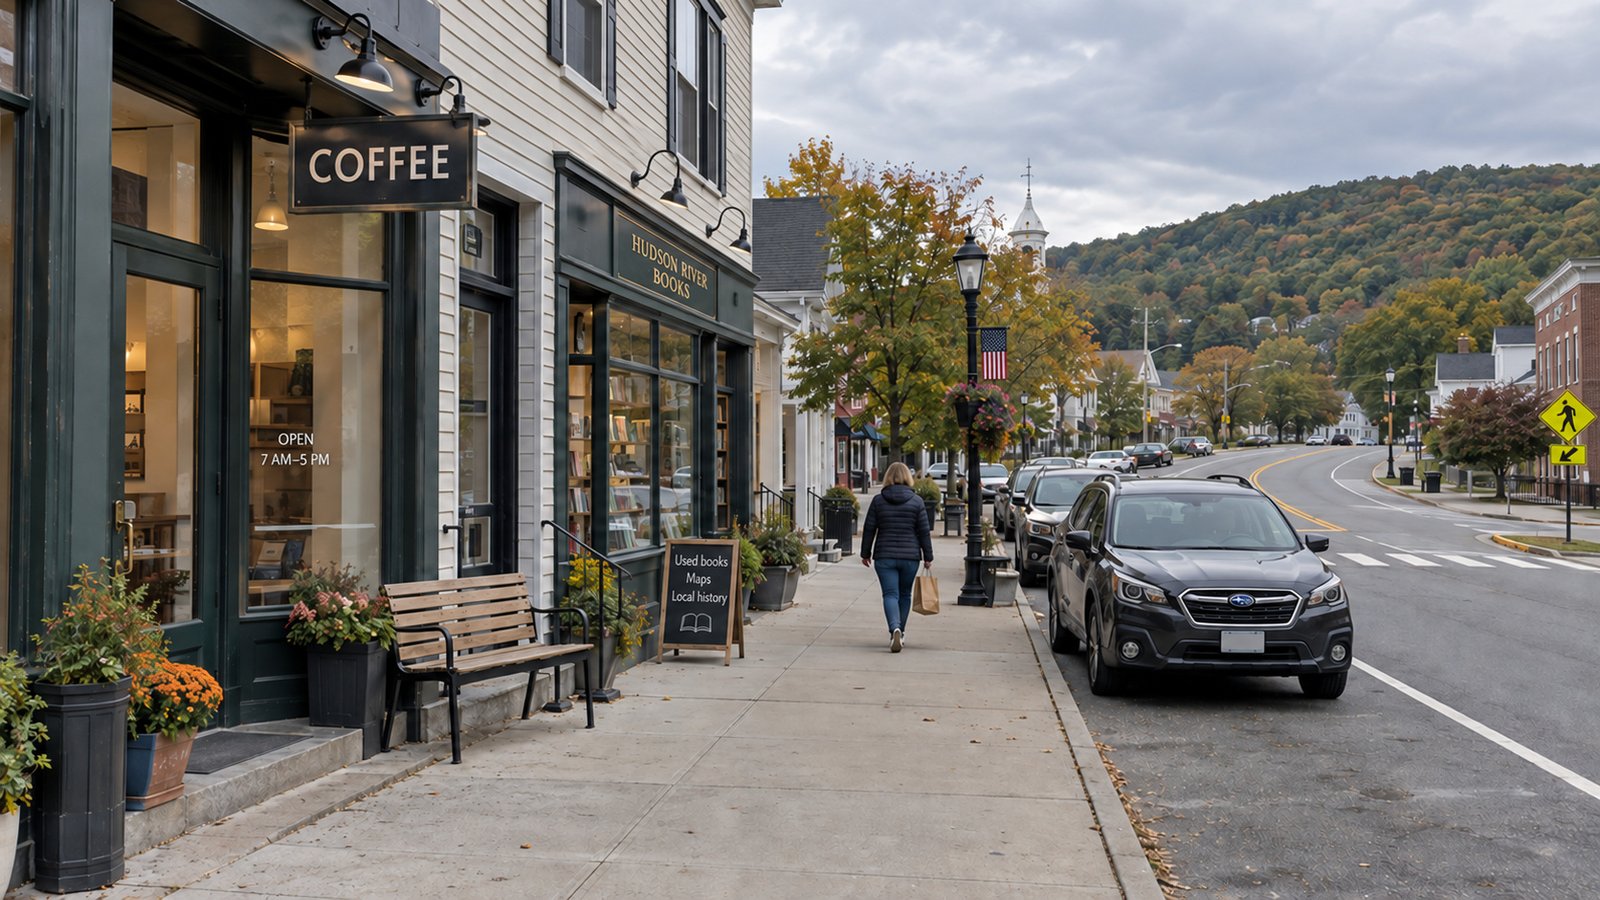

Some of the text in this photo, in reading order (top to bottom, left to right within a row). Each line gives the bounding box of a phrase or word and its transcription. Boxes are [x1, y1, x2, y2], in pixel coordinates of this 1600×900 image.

[309, 144, 449, 183] COFFEE
[632, 233, 708, 290] HUDSON RIVER
[653, 267, 690, 299] BOOKS
[278, 432, 314, 446] OPEN
[260, 453, 268, 466] 7
[311, 453, 330, 466] PM
[675, 554, 728, 568] Used books
[686, 572, 711, 587] Maps
[672, 590, 728, 606] Local history
